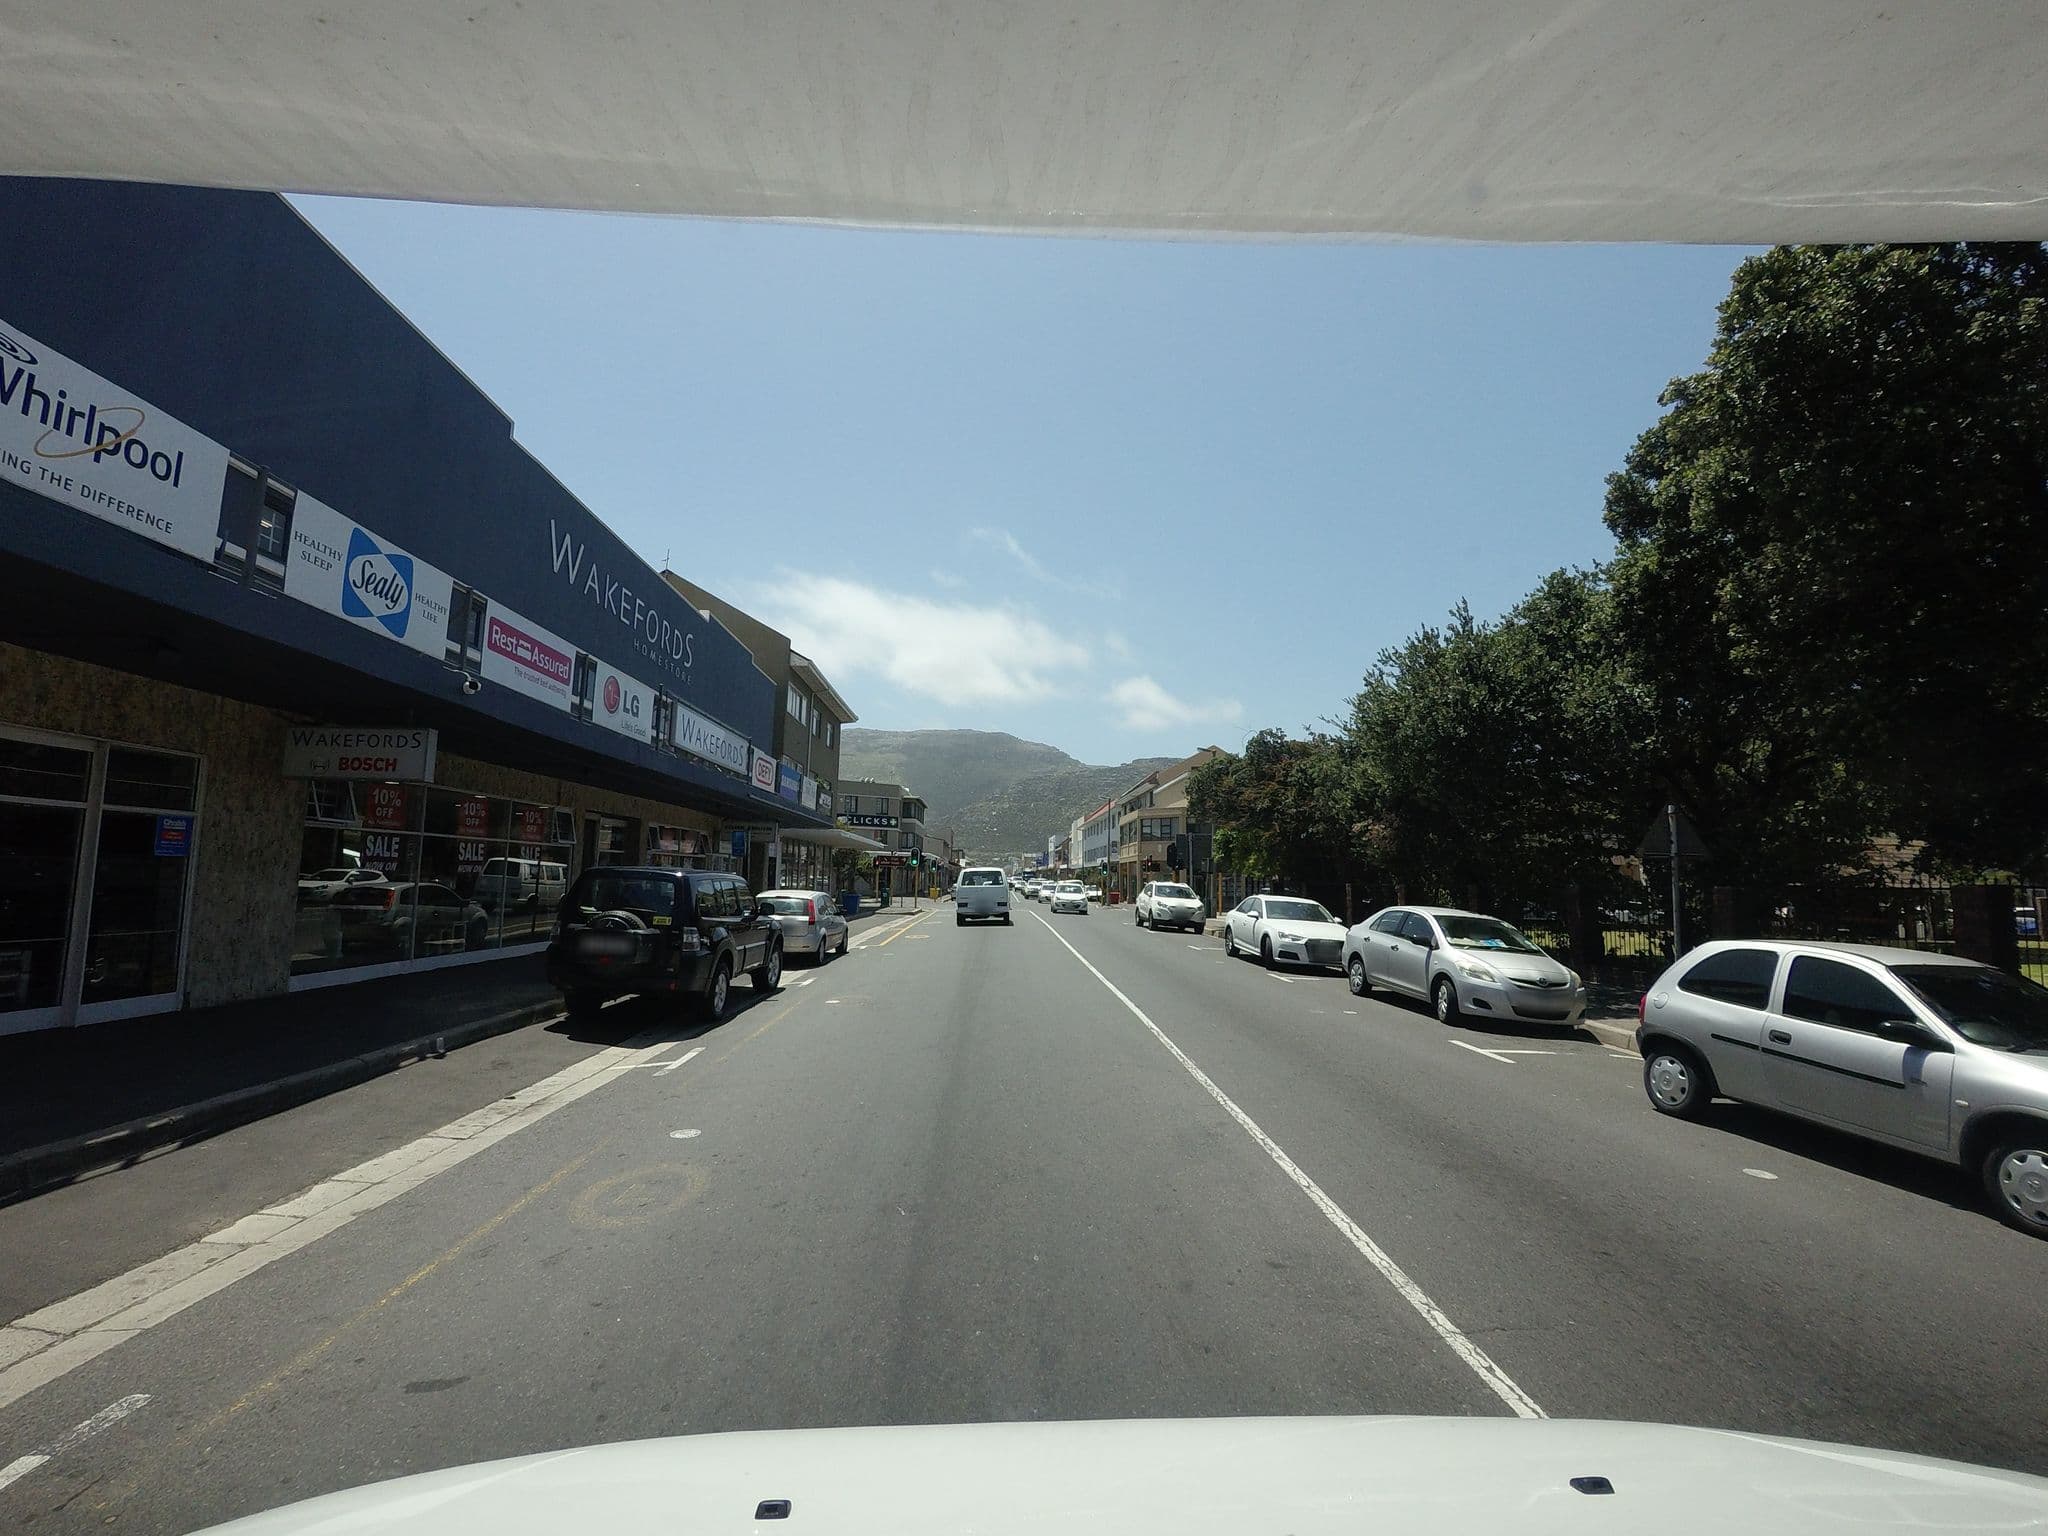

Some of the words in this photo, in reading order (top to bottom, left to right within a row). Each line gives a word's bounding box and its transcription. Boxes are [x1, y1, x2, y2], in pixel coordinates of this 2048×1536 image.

[0, 357, 184, 488] Whirlpool
[39, 466, 74, 492] THE
[80, 484, 174, 534] DIFFERENCE
[294, 530, 344, 562] HEALTHY
[300, 550, 333, 572] SLEEP
[352, 559, 404, 610] Sealy
[550, 519, 694, 668] WAKEFORDS
[414, 592, 449, 616] HEALTHY
[422, 609, 438, 624] LIFE
[491, 624, 518, 654] Rest
[531, 646, 570, 679] Assured
[633, 638, 692, 685] HOMESTORE
[623, 690, 640, 718] LG
[292, 730, 422, 748] WAKEFORDS
[681, 714, 744, 766] WAKEFORDS
[338, 757, 398, 772] BOSCH
[372, 788, 402, 807] 10%
[463, 802, 486, 817] 10%
[375, 807, 394, 818] OFF
[464, 817, 480, 826] OFF
[847, 815, 888, 826] CLICKS
[366, 834, 400, 858] SALE
[458, 842, 485, 861] SALE
